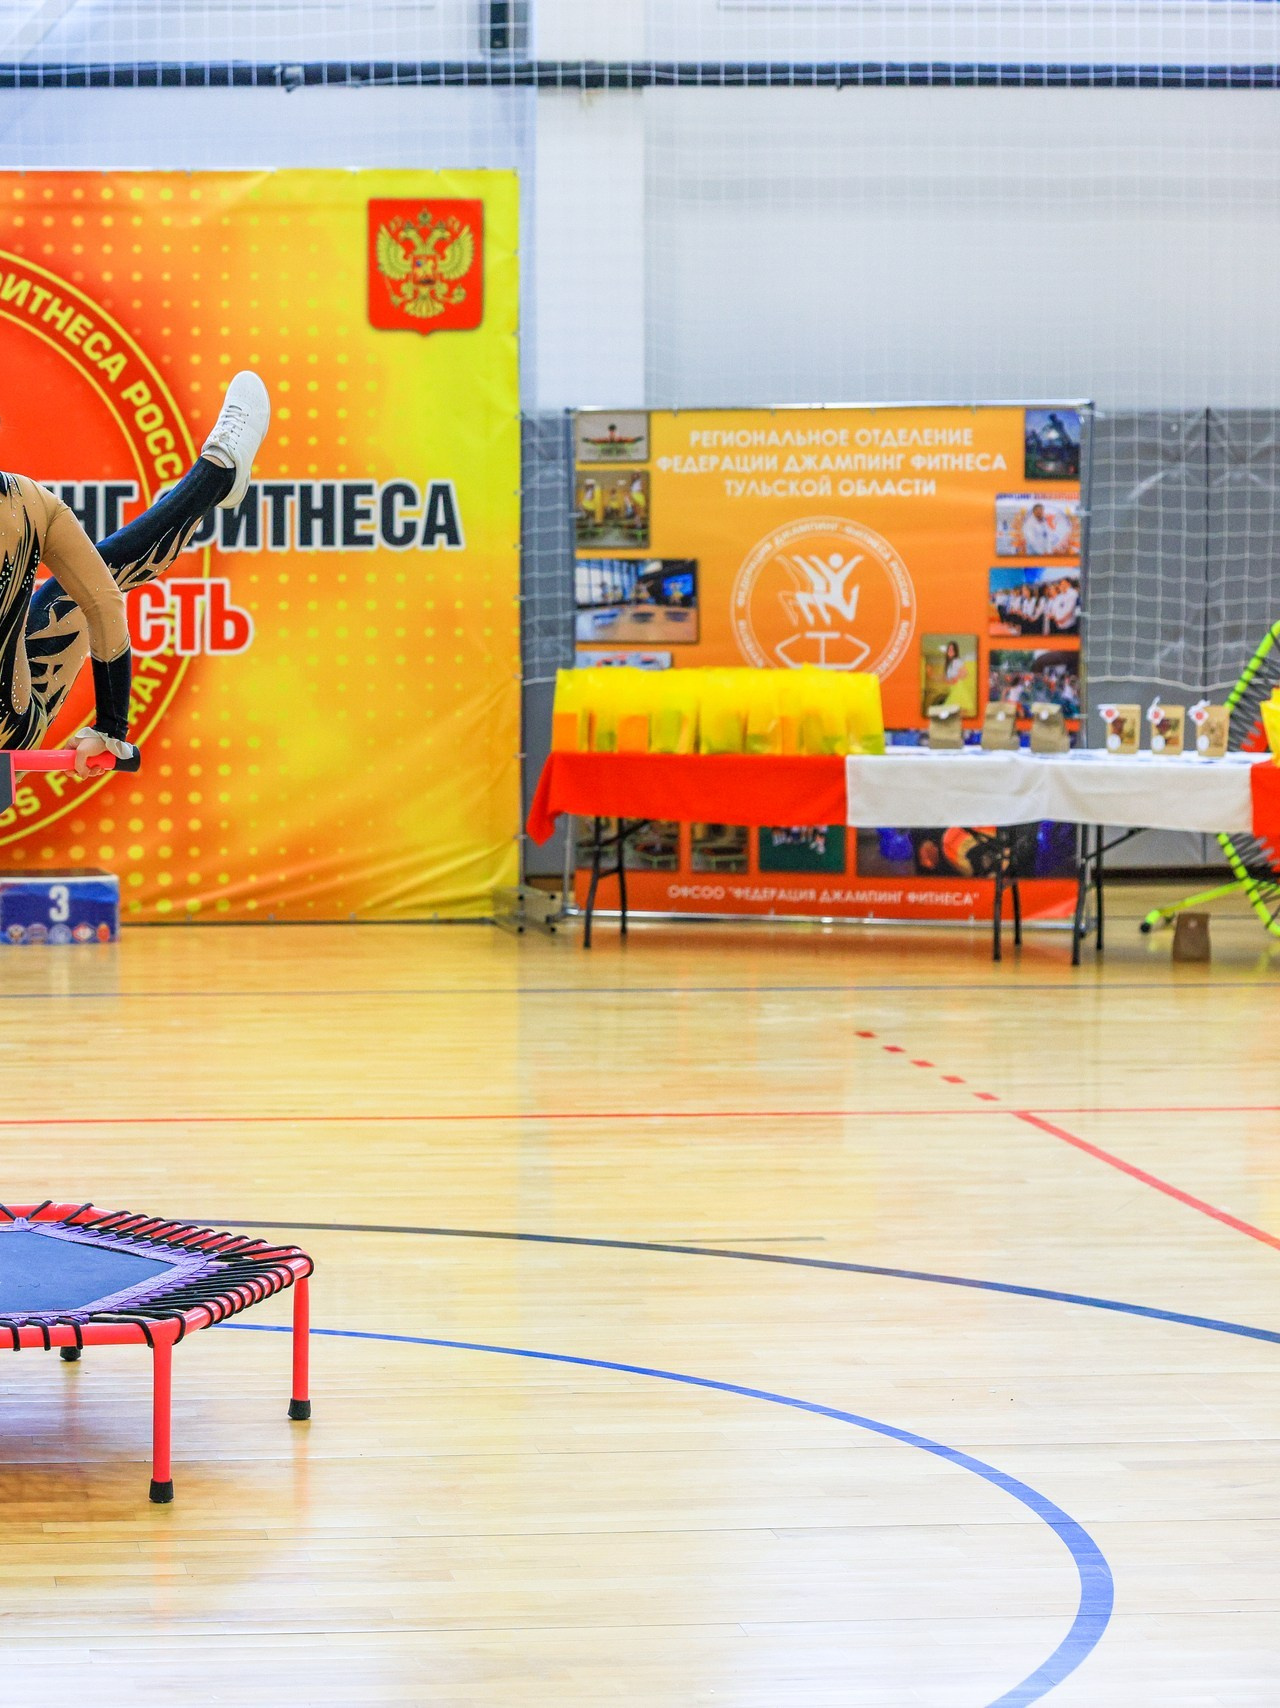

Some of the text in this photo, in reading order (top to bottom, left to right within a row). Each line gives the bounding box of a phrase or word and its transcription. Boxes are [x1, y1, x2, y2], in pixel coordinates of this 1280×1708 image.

[121, 379, 184, 490] РОСС
[689, 427, 973, 448] РЕГИОНАЛЬНОЕ ОТДЕЛЕНИЕ
[656, 453, 1007, 474] ФЕДЕРАЦИИ ДЖАМПИНГ ФИТНЕСА
[724, 475, 937, 497] ТУЛЬСКОЙ ОБЛАСТИ
[49, 886, 69, 921] 3
